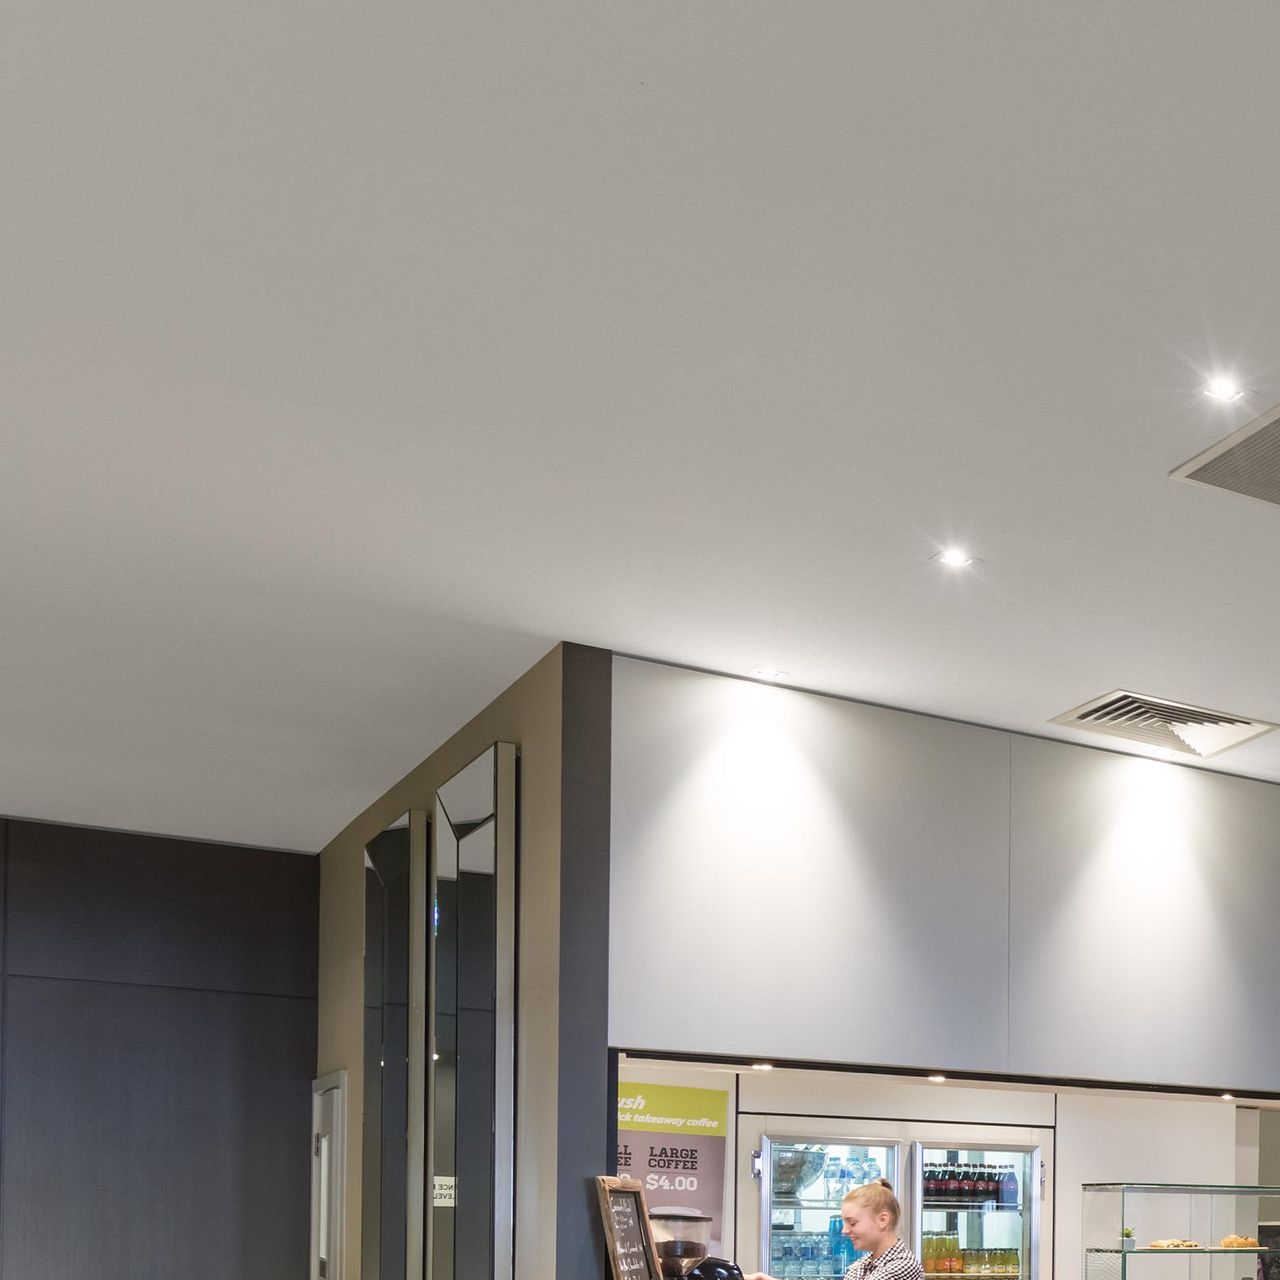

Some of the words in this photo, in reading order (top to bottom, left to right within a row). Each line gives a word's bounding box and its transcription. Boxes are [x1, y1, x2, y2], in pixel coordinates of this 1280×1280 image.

[634, 1114, 686, 1127] takeaway
[687, 1117, 719, 1128] coffee
[649, 1146, 697, 1159] LARGE
[648, 1158, 697, 1169] COFFEE
[646, 1174, 697, 1190] $4.00
